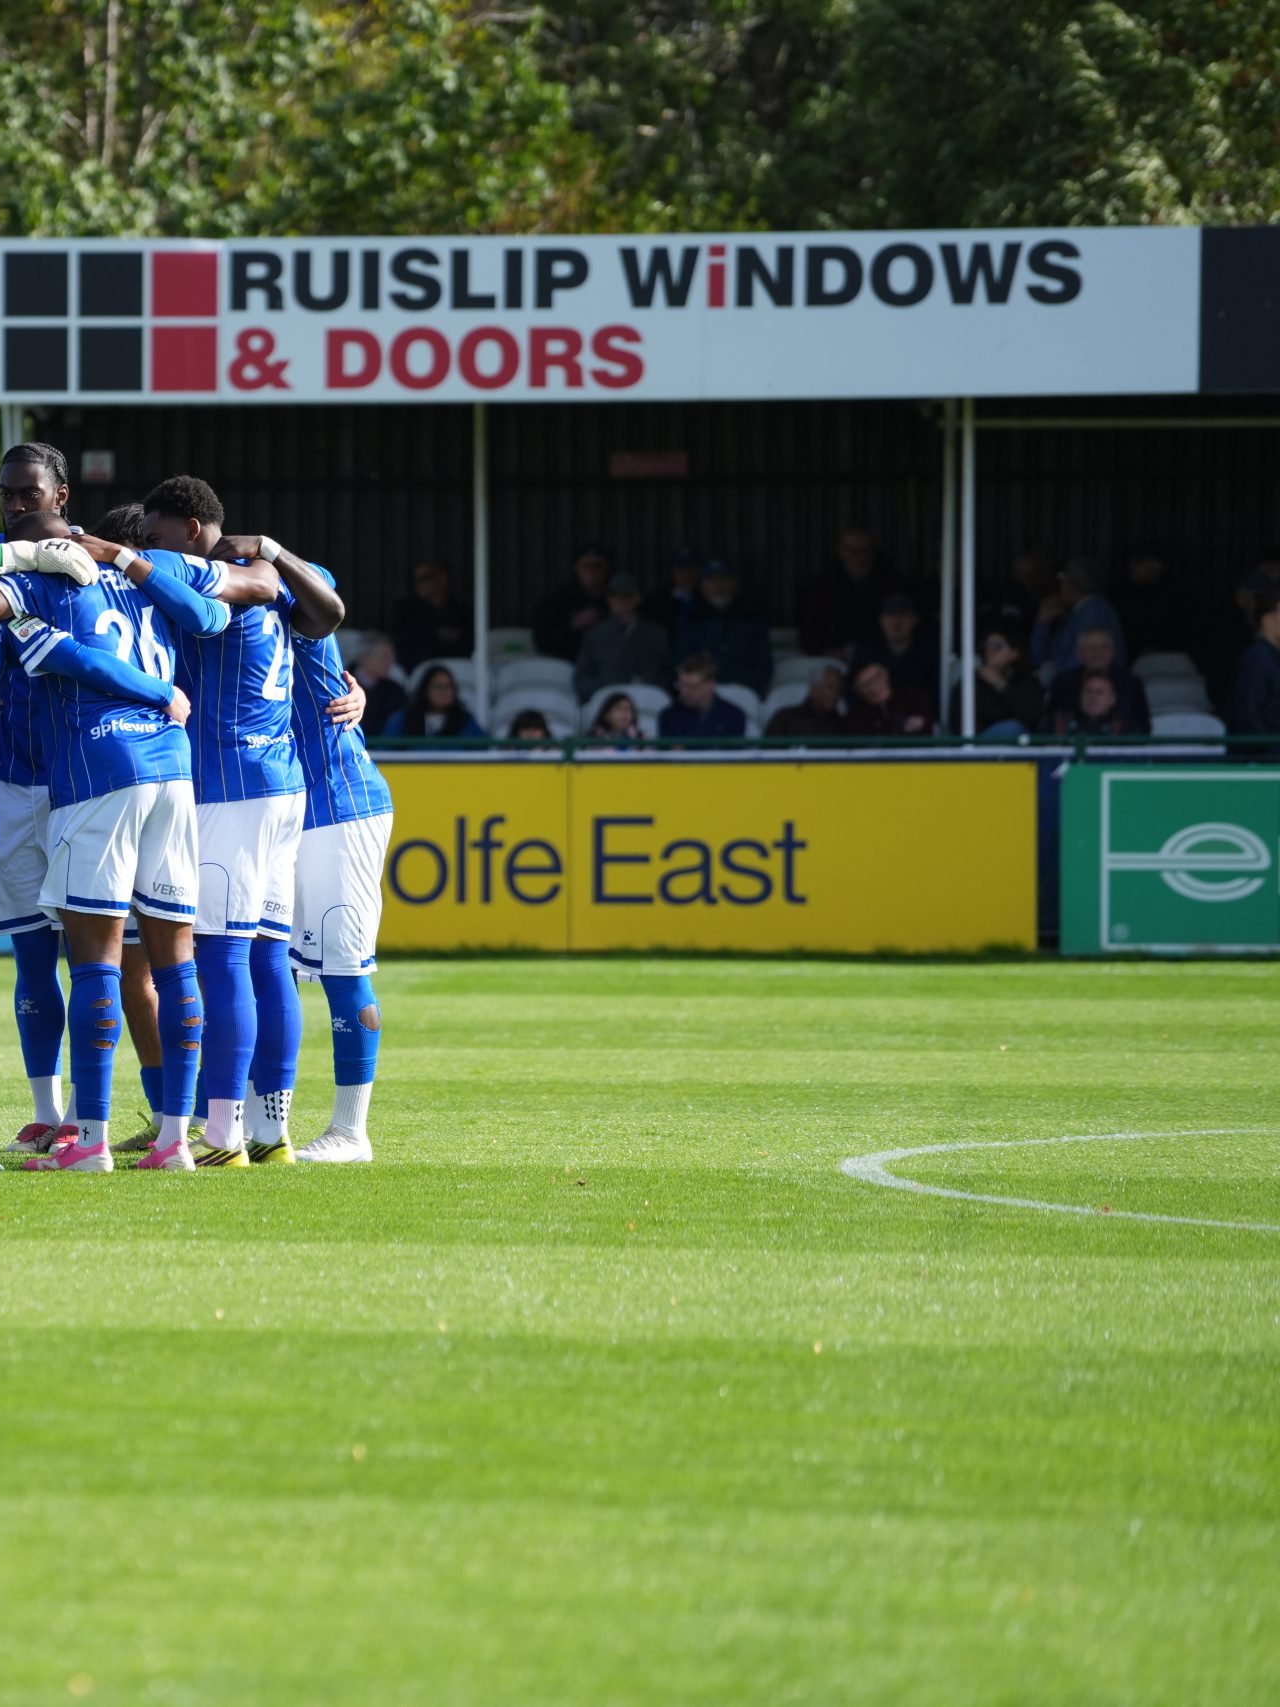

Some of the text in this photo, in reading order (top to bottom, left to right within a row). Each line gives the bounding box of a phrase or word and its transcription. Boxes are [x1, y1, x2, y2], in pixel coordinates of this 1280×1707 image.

[229, 248, 589, 312] RUISLIP
[228, 325, 646, 390] & DOORS
[95, 605, 171, 683] 26
[262, 610, 295, 701] 2
[388, 814, 808, 906] olfe East
